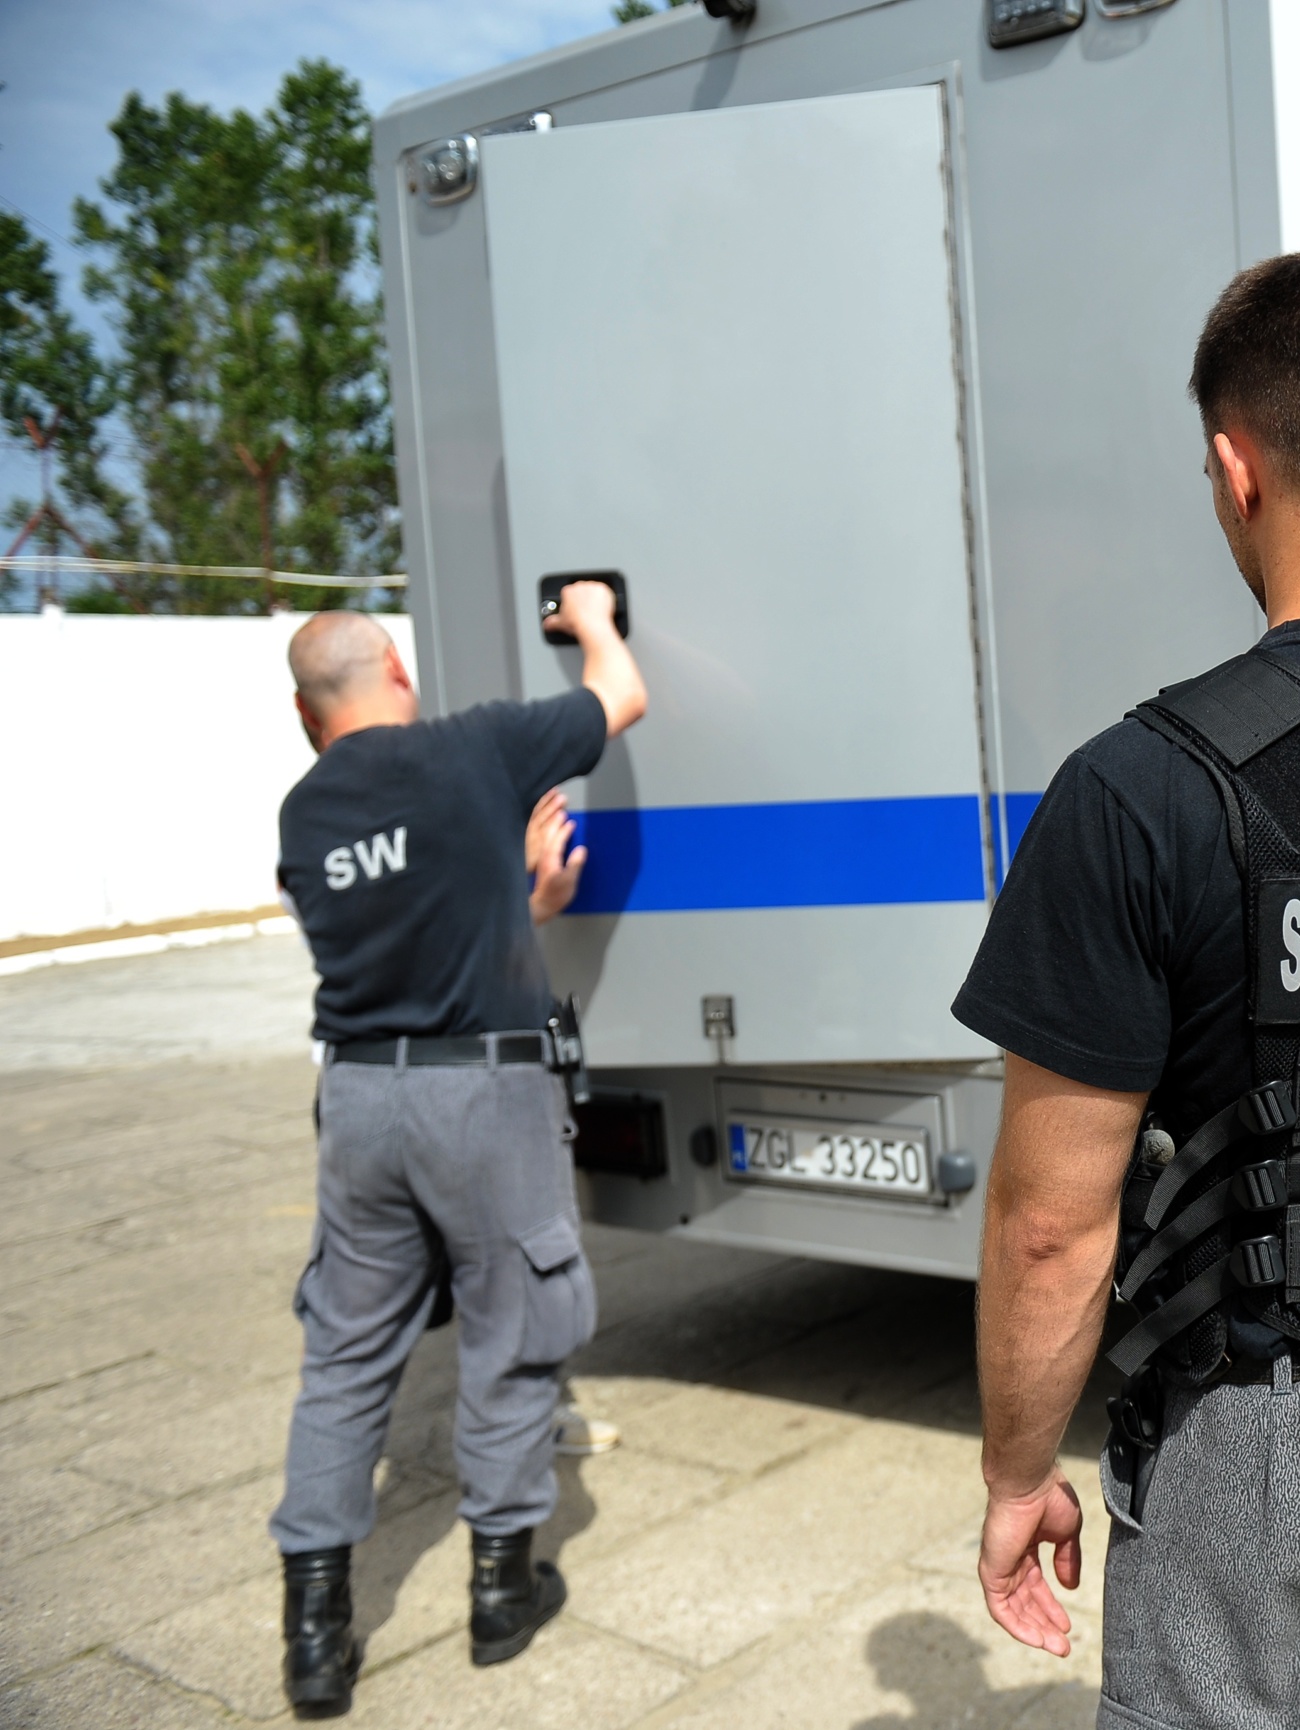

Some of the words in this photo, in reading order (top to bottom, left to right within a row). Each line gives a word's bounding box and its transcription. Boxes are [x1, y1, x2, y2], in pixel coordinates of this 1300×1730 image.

[324, 826, 407, 890] SW
[748, 1127, 806, 1173] ZGL
[817, 1135, 921, 1184] 33250
